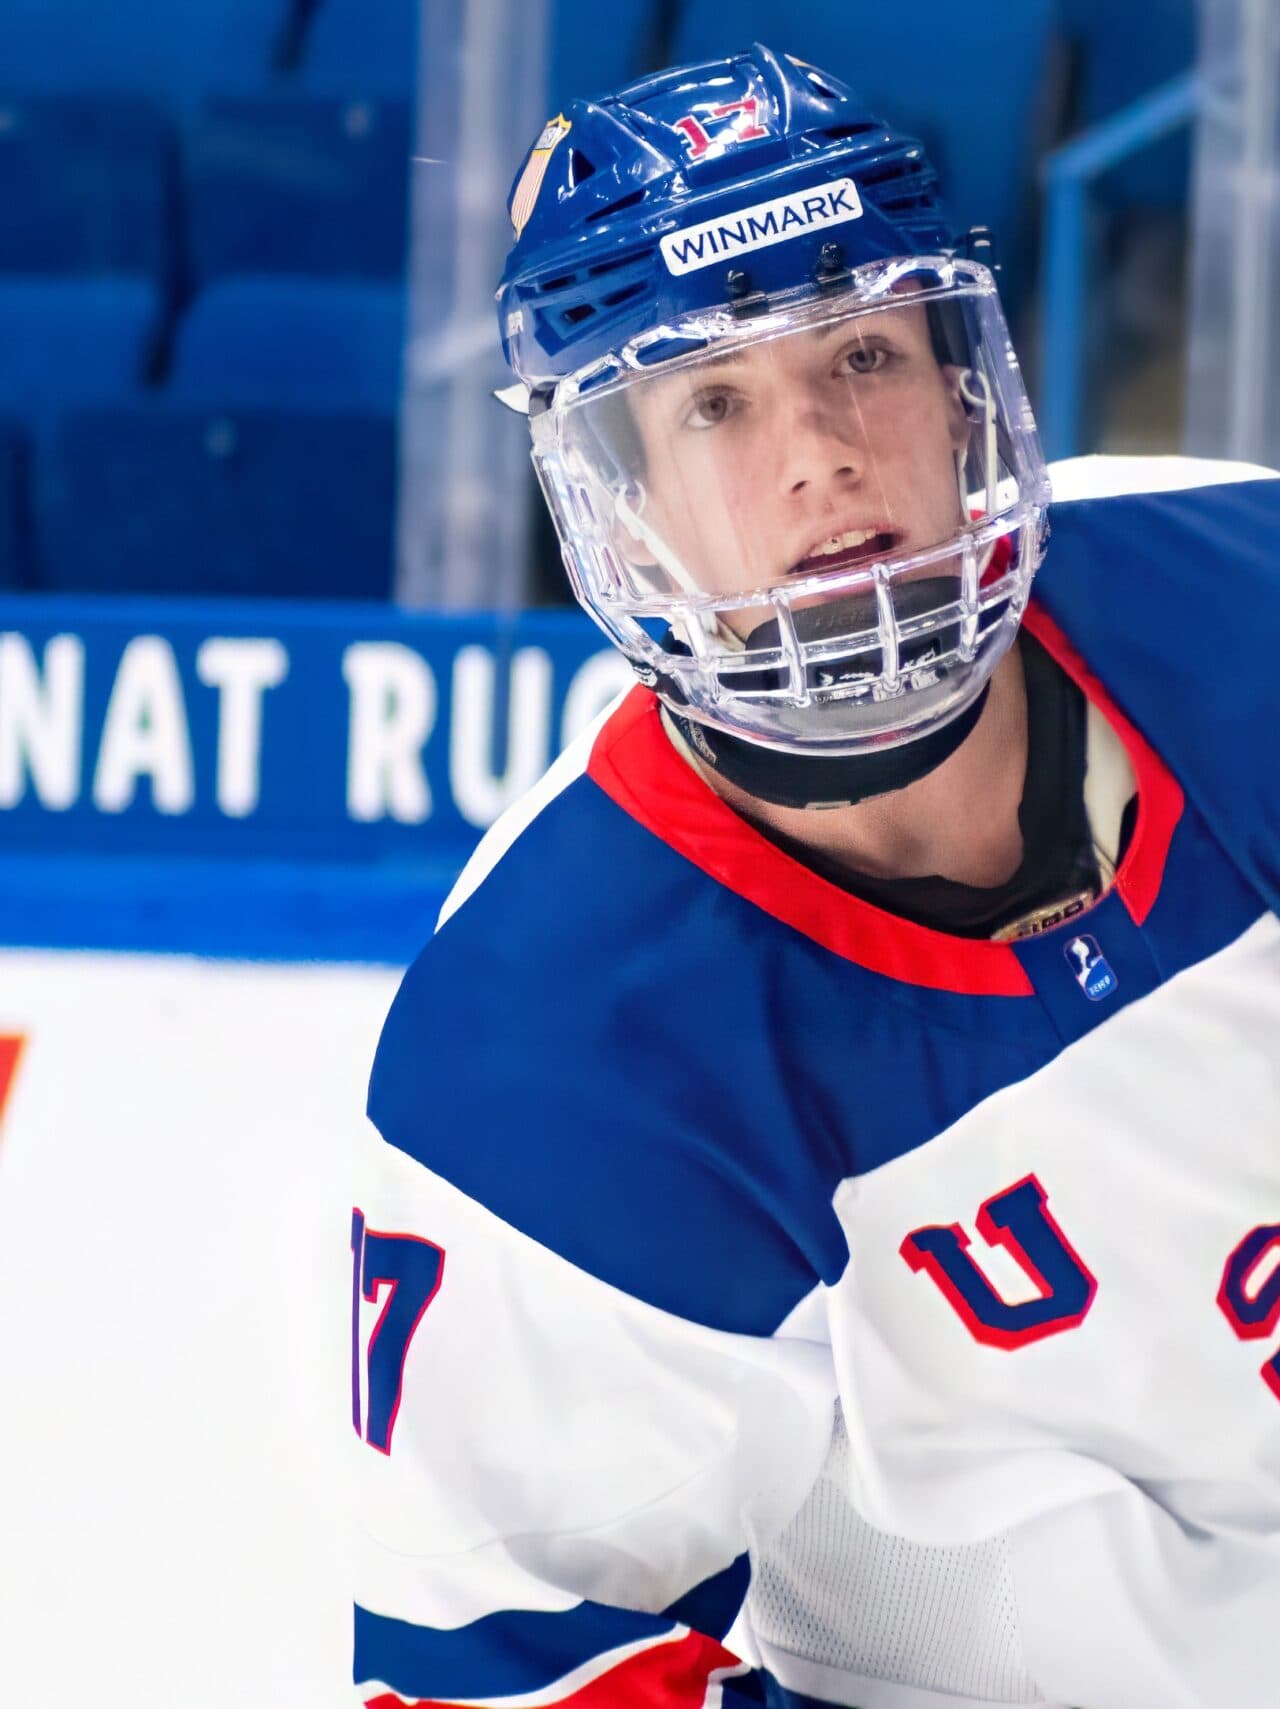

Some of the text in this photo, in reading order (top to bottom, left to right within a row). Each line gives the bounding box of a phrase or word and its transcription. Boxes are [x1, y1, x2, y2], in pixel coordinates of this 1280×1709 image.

[673, 95, 771, 161] 17
[671, 188, 856, 265] WINMARK
[0, 631, 289, 818] NAT
